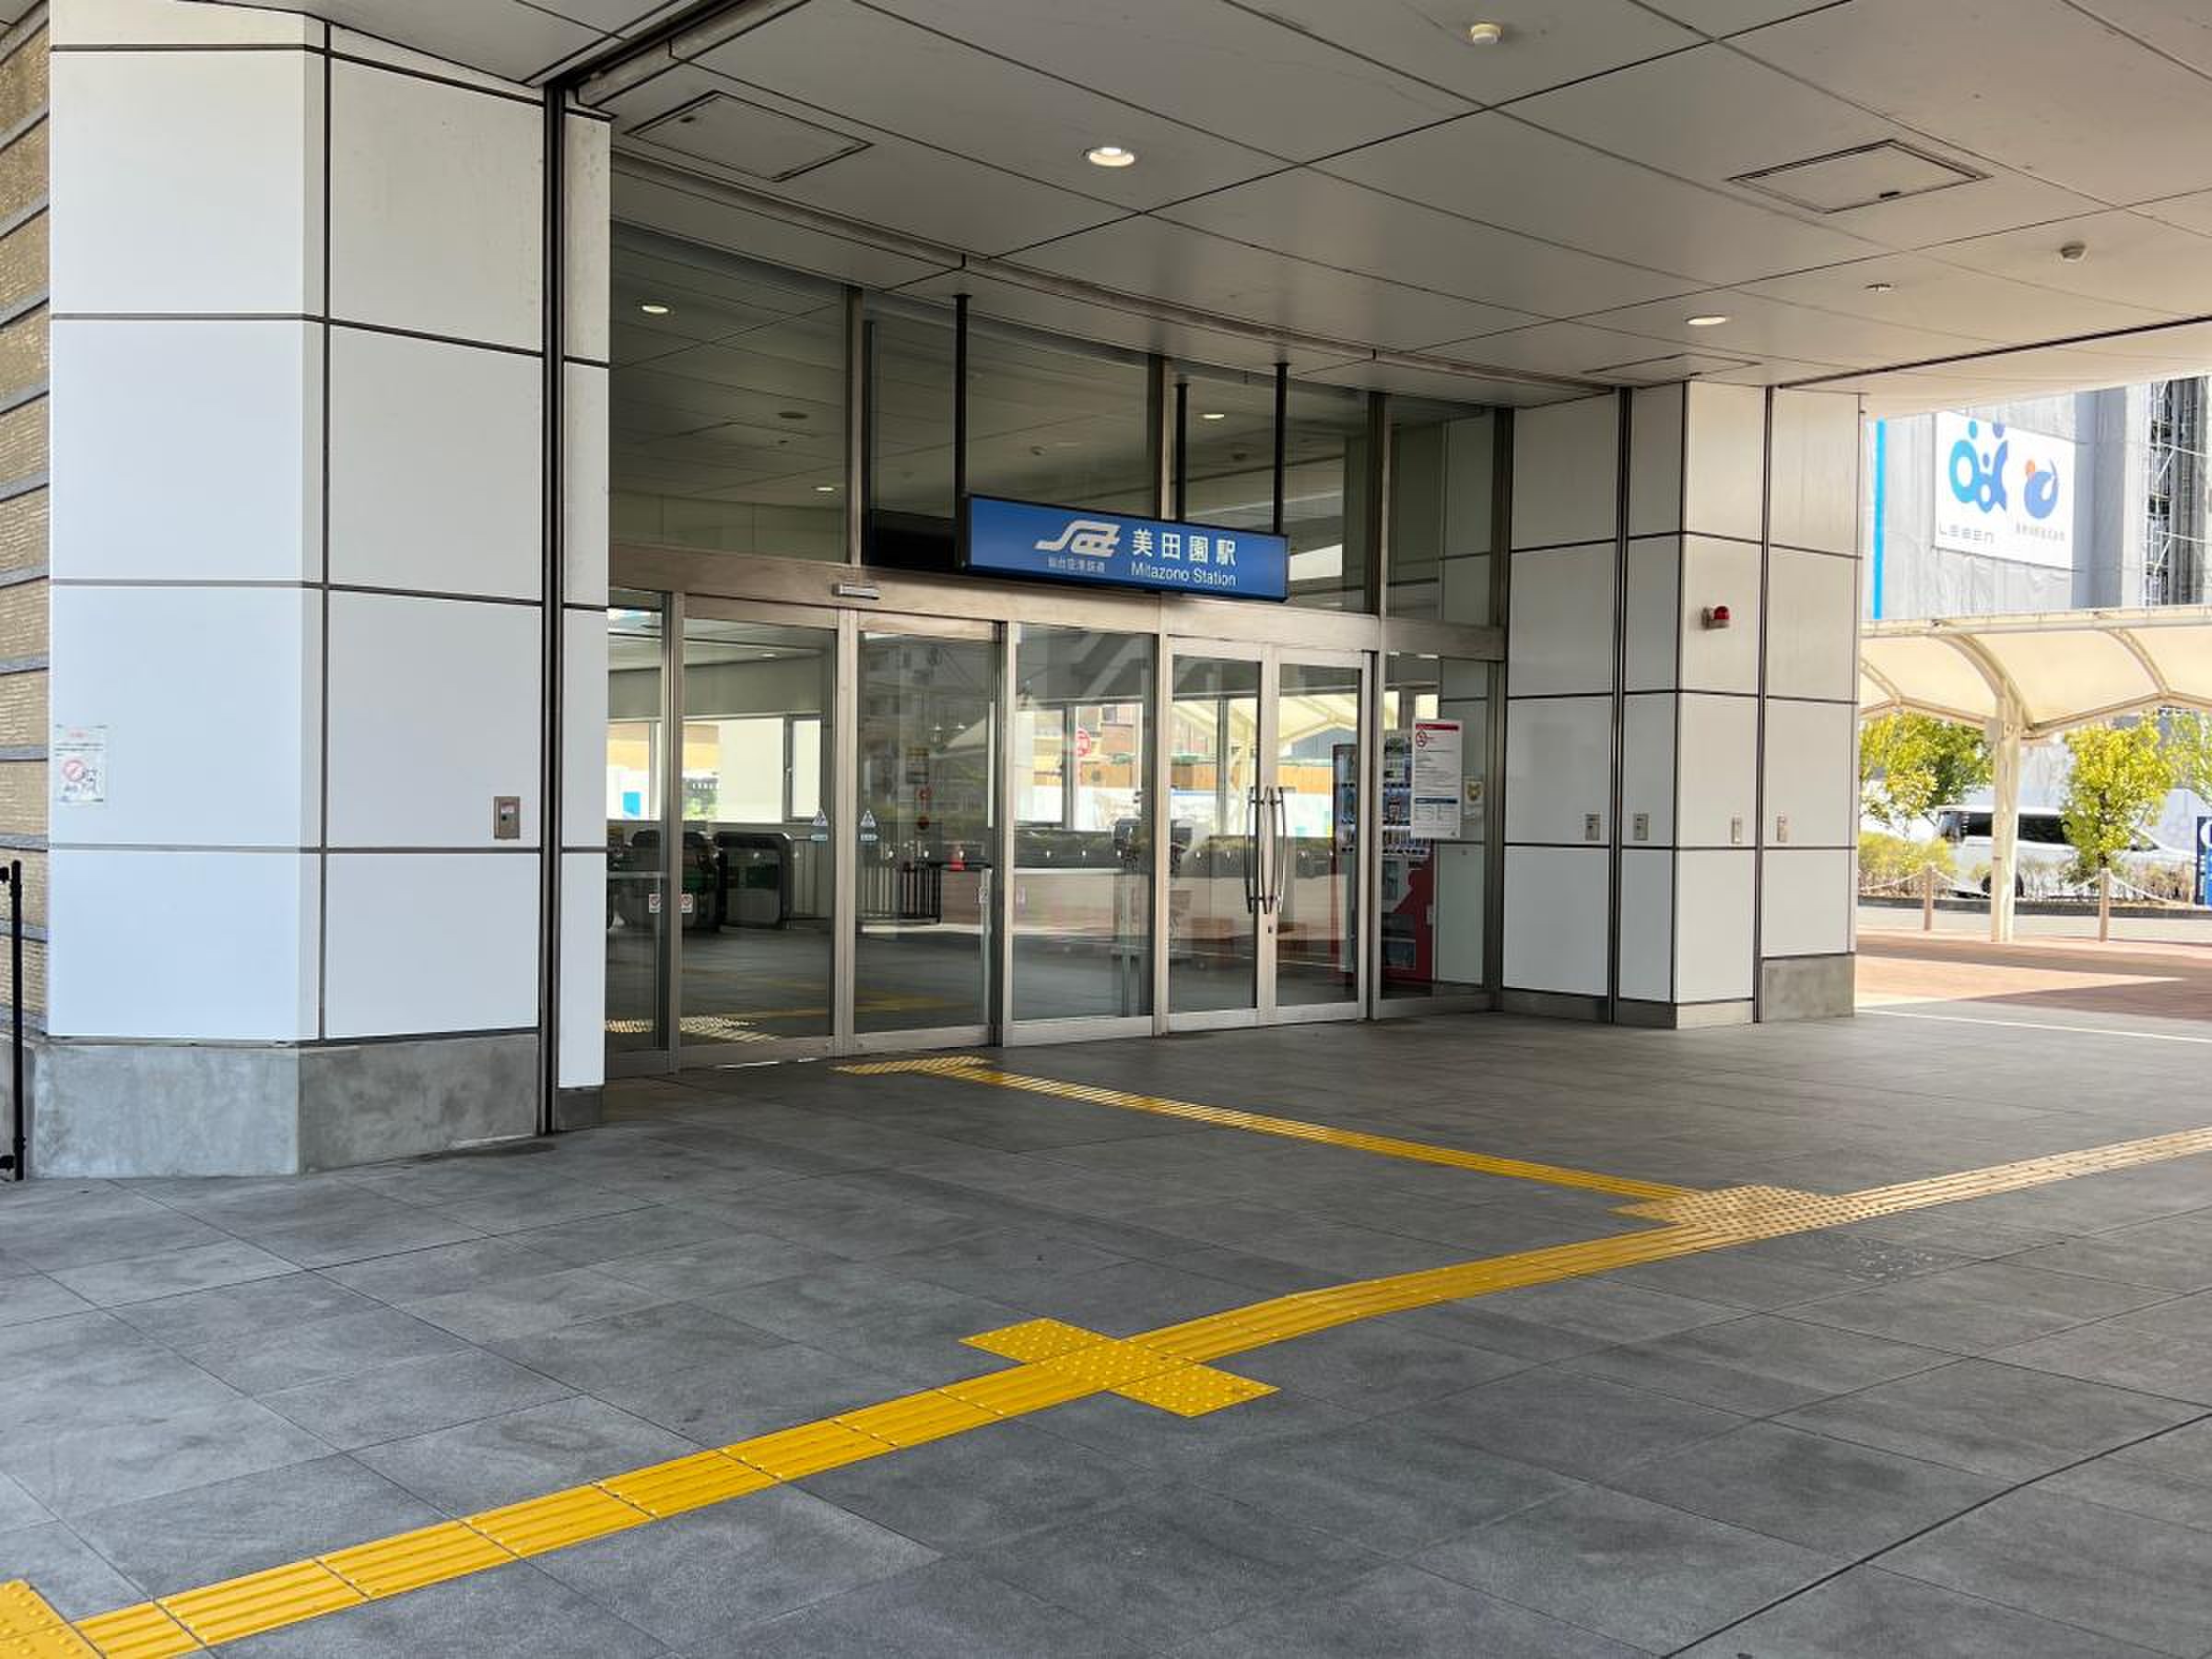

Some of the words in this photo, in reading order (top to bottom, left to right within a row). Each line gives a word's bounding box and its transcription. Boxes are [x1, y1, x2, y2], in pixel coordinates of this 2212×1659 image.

[1132, 528, 1236, 567] 美田園駅
[1130, 560, 1190, 582] Mitazono
[1194, 567, 1239, 587] Station
